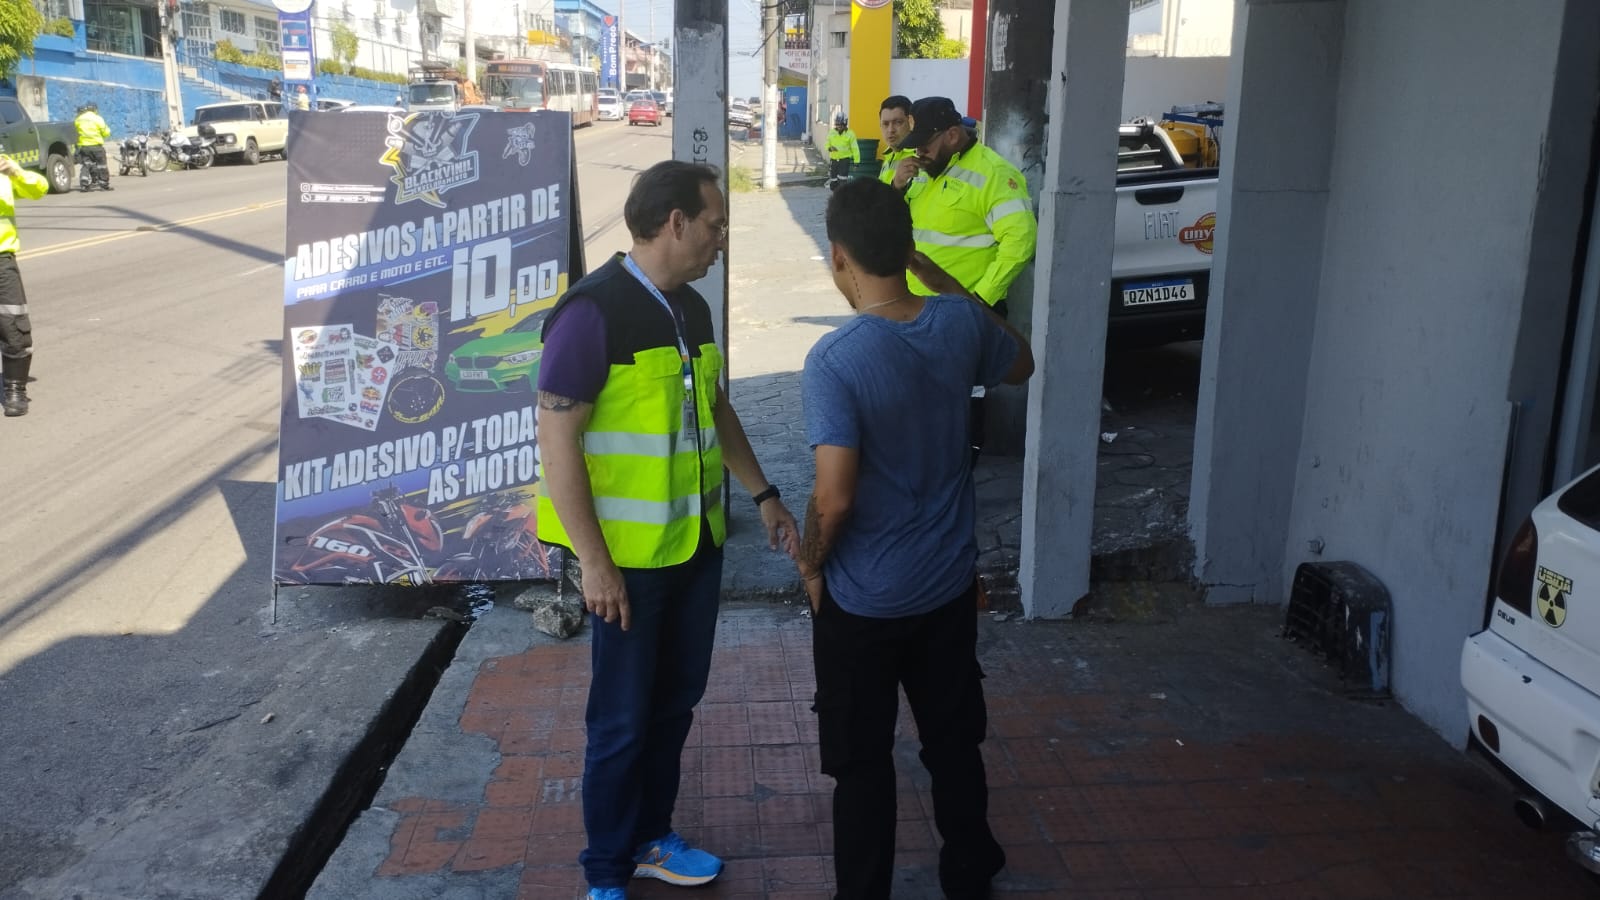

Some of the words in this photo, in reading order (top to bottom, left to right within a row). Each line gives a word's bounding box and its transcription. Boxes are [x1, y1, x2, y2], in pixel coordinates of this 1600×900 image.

[609, 54, 617, 76] Bom
[295, 221, 416, 281] ADESIVOS
[421, 216, 438, 252] A
[442, 193, 526, 248] PARTIR
[531, 183, 560, 224] DE
[1144, 209, 1180, 240] FIAT
[296, 285, 327, 299] PARA
[330, 273, 367, 292] CARRO
[370, 271, 378, 282] E
[380, 263, 411, 280] MOTO
[414, 260, 422, 271] E
[424, 254, 448, 267] ETC.
[1128, 286, 1187, 304] QZN1D46
[284, 458, 327, 500] KIT
[330, 431, 437, 490] ADESIVO
[442, 422, 468, 463] P/
[472, 404, 540, 454] TODA
[427, 464, 460, 505] AS
[313, 536, 371, 557] 160
